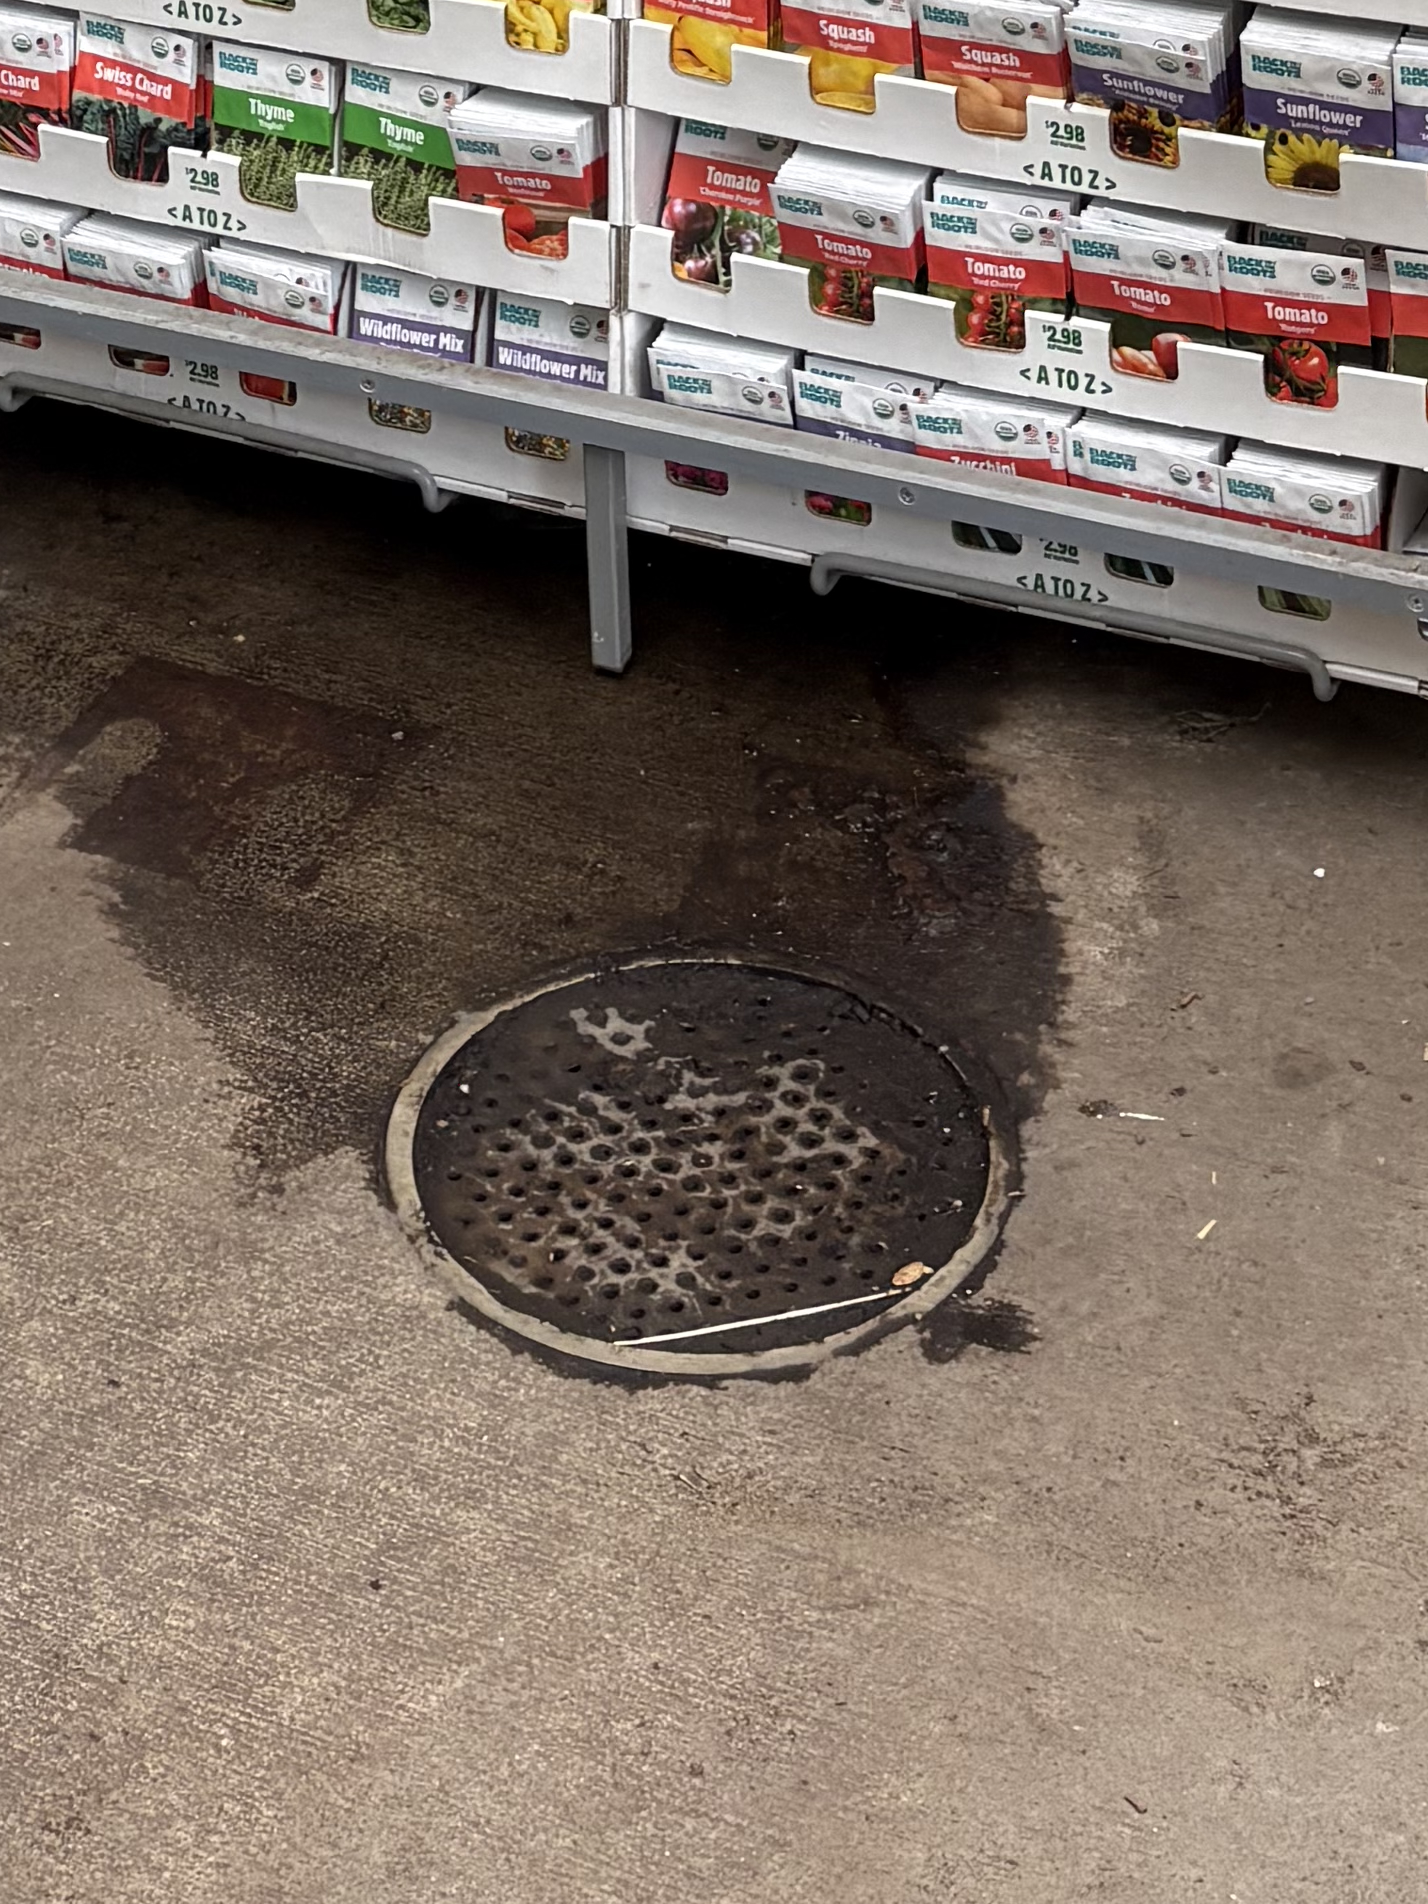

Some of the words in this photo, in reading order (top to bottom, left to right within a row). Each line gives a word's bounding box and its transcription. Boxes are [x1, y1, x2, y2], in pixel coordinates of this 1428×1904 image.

[1, 70, 39, 97] Chard
[249, 98, 294, 122] Thyme
[1277, 98, 1363, 131] Sunflower
[1264, 302, 1328, 324] Tomato
[360, 315, 436, 349] Wildflower
[435, 333, 464, 354] Mix
